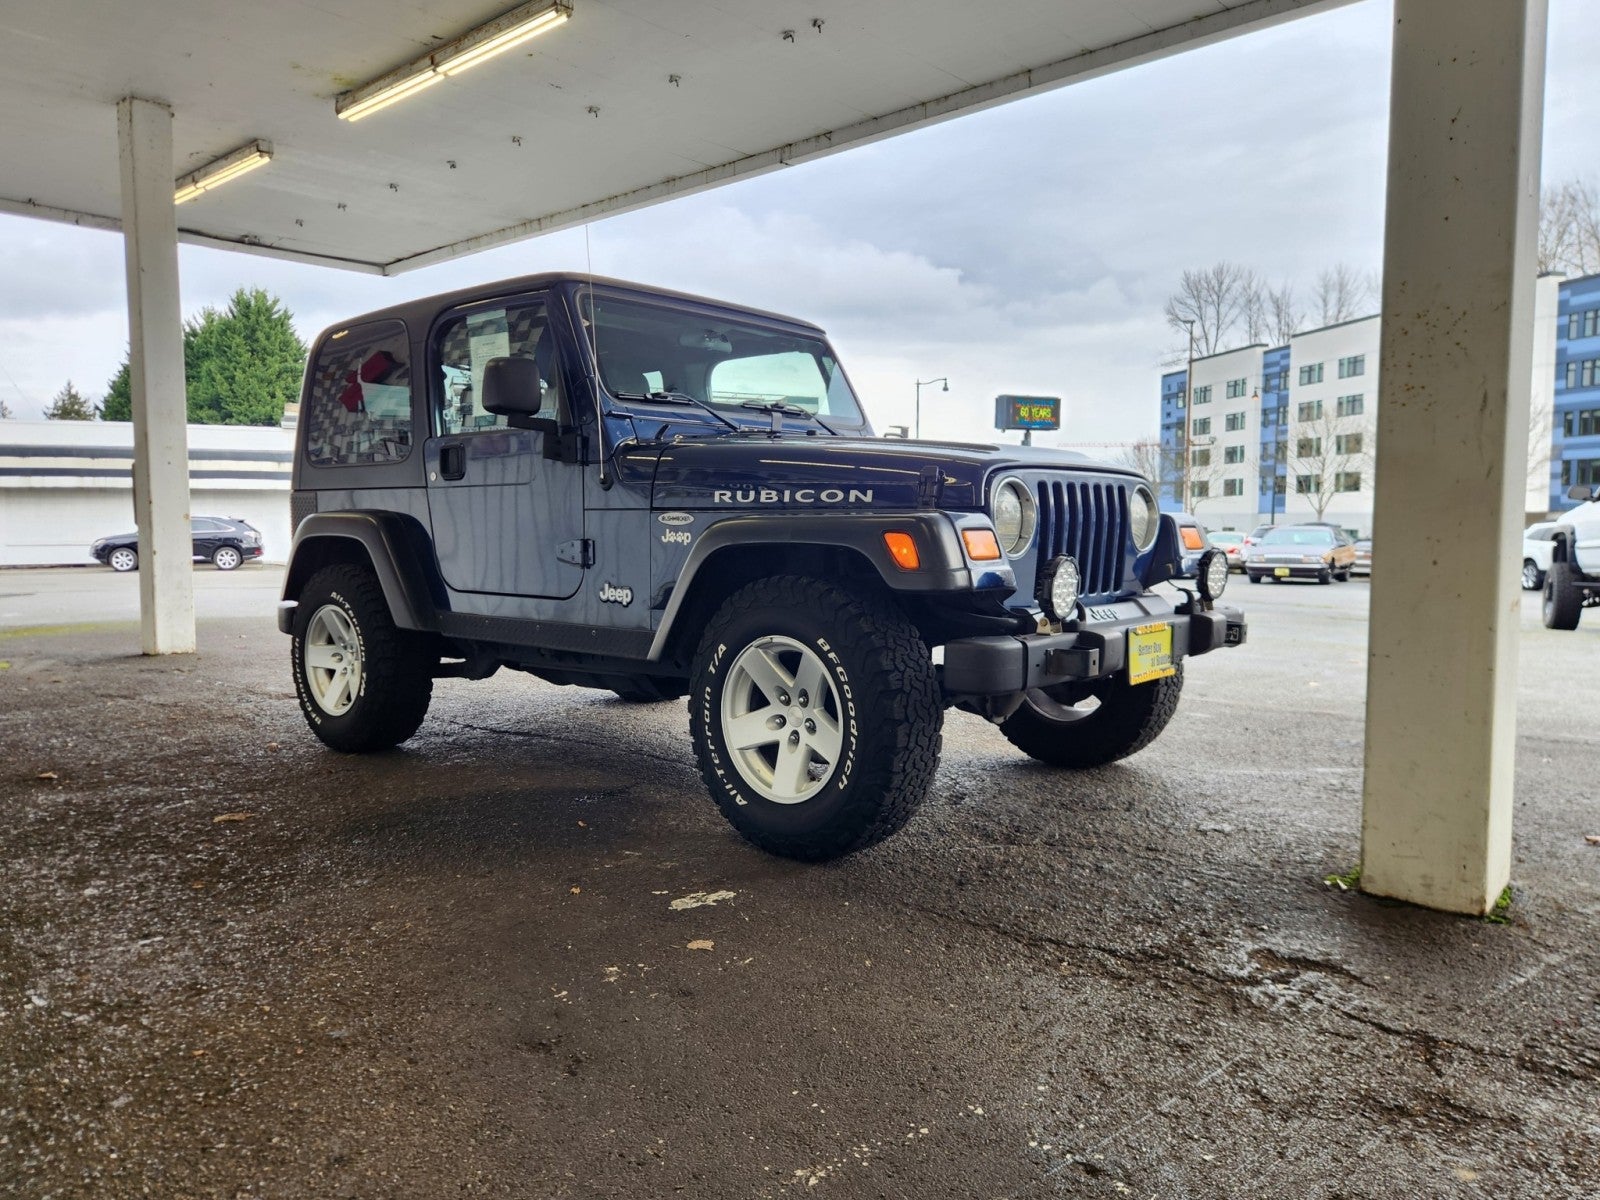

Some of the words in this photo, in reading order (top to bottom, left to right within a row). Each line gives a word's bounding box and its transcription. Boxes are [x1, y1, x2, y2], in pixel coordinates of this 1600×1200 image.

[1020, 407, 1029, 418] 60
[1031, 407, 1051, 418] YEARS
[713, 489, 874, 503] RUBICON
[599, 582, 633, 606] Jeep
[707, 643, 728, 675] T/A
[816, 637, 859, 791] BFGoodrich
[703, 686, 748, 807] All-Terrain
